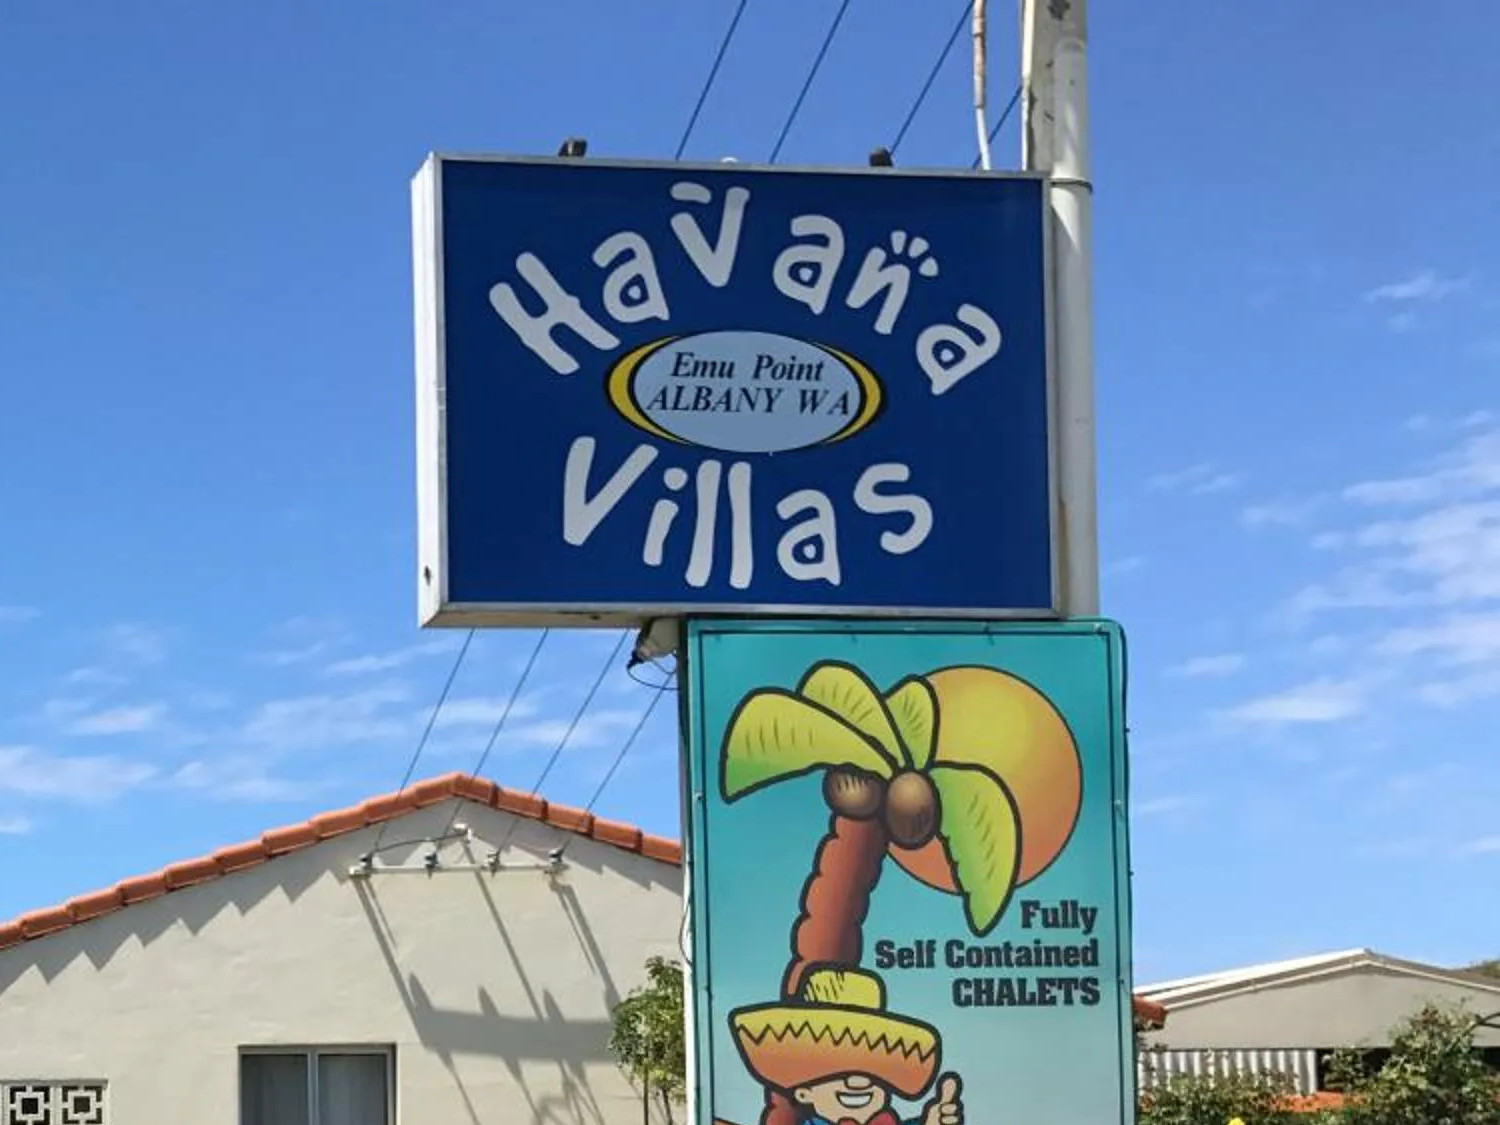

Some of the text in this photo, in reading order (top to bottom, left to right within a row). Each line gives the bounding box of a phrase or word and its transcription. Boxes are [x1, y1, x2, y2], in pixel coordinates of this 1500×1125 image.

[670, 352, 824, 382] Emu Point
[646, 386, 851, 417] ALBANY WA
[563, 436, 933, 590] Villas
[1020, 900, 1098, 935] Fully
[875, 938, 1099, 969] Self Contained
[951, 977, 1101, 1008] CHALETS
